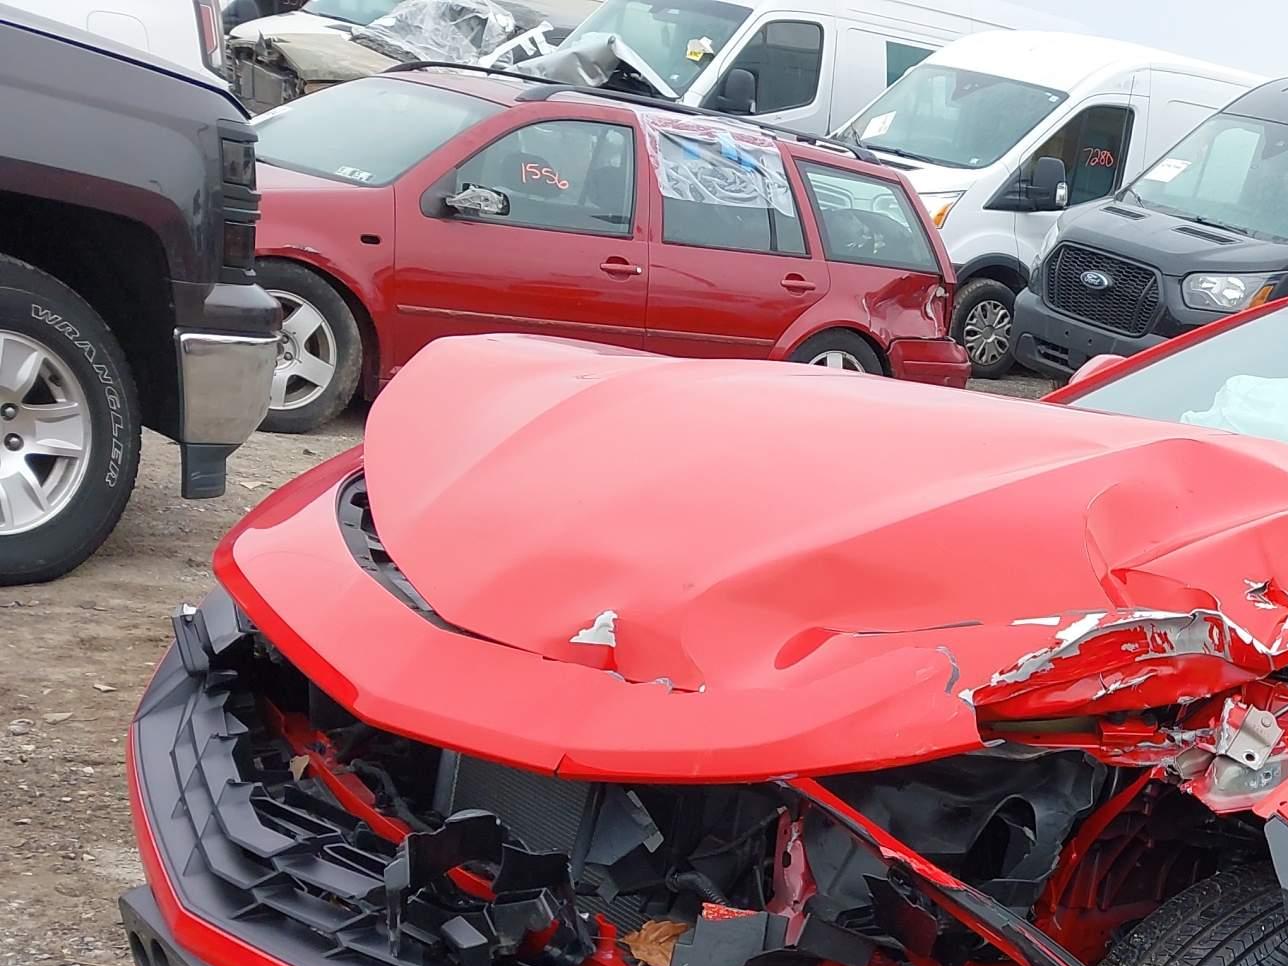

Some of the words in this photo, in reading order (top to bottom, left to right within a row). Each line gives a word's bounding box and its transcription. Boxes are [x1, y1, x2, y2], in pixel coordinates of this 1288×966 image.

[1082, 147, 1114, 167] 7280
[521, 162, 569, 190] 1556
[31, 303, 124, 487] WRANGLER
